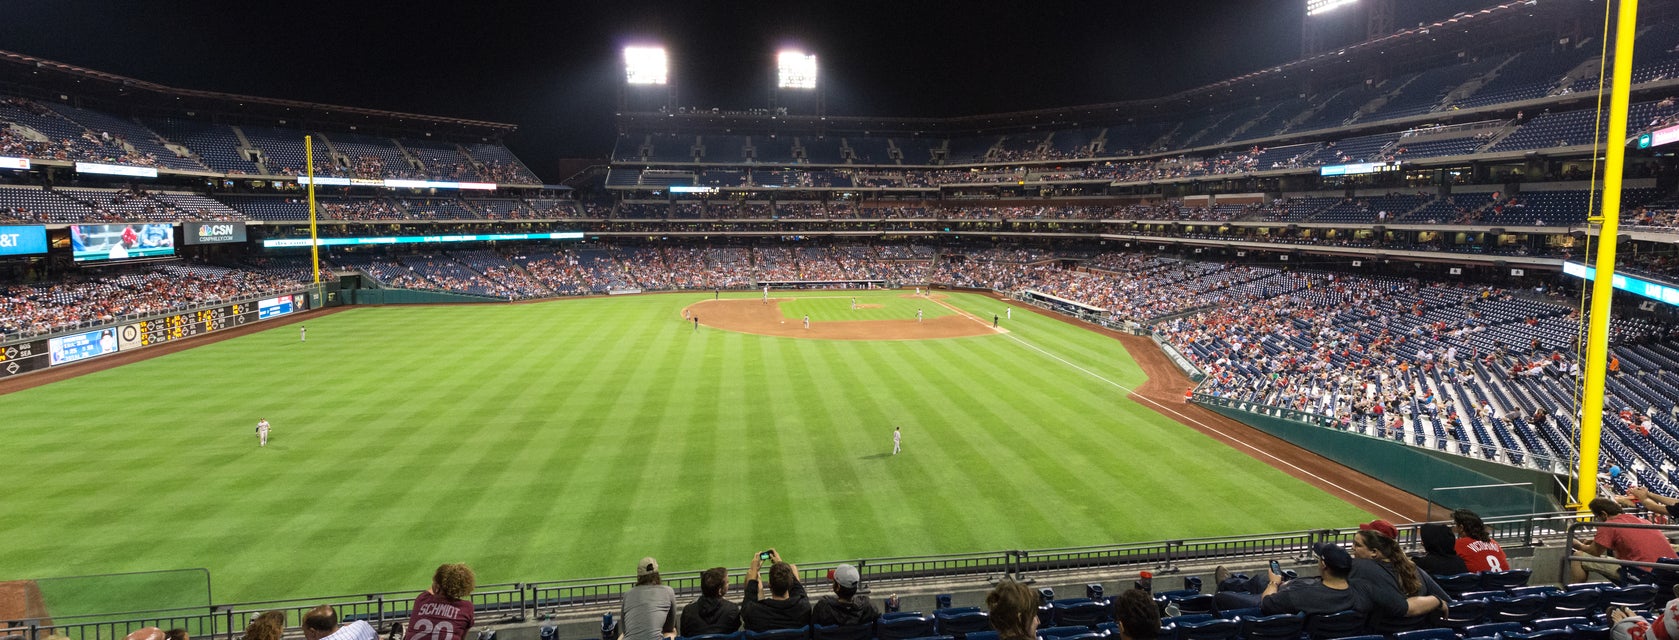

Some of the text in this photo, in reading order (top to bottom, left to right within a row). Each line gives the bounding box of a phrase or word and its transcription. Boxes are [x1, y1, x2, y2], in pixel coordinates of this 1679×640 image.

[212, 224, 234, 236] CSN
[20, 350, 32, 358] SEA
[1485, 555, 1503, 573] 8
[418, 602, 461, 619] SCHMIDT
[410, 618, 454, 640] 20
